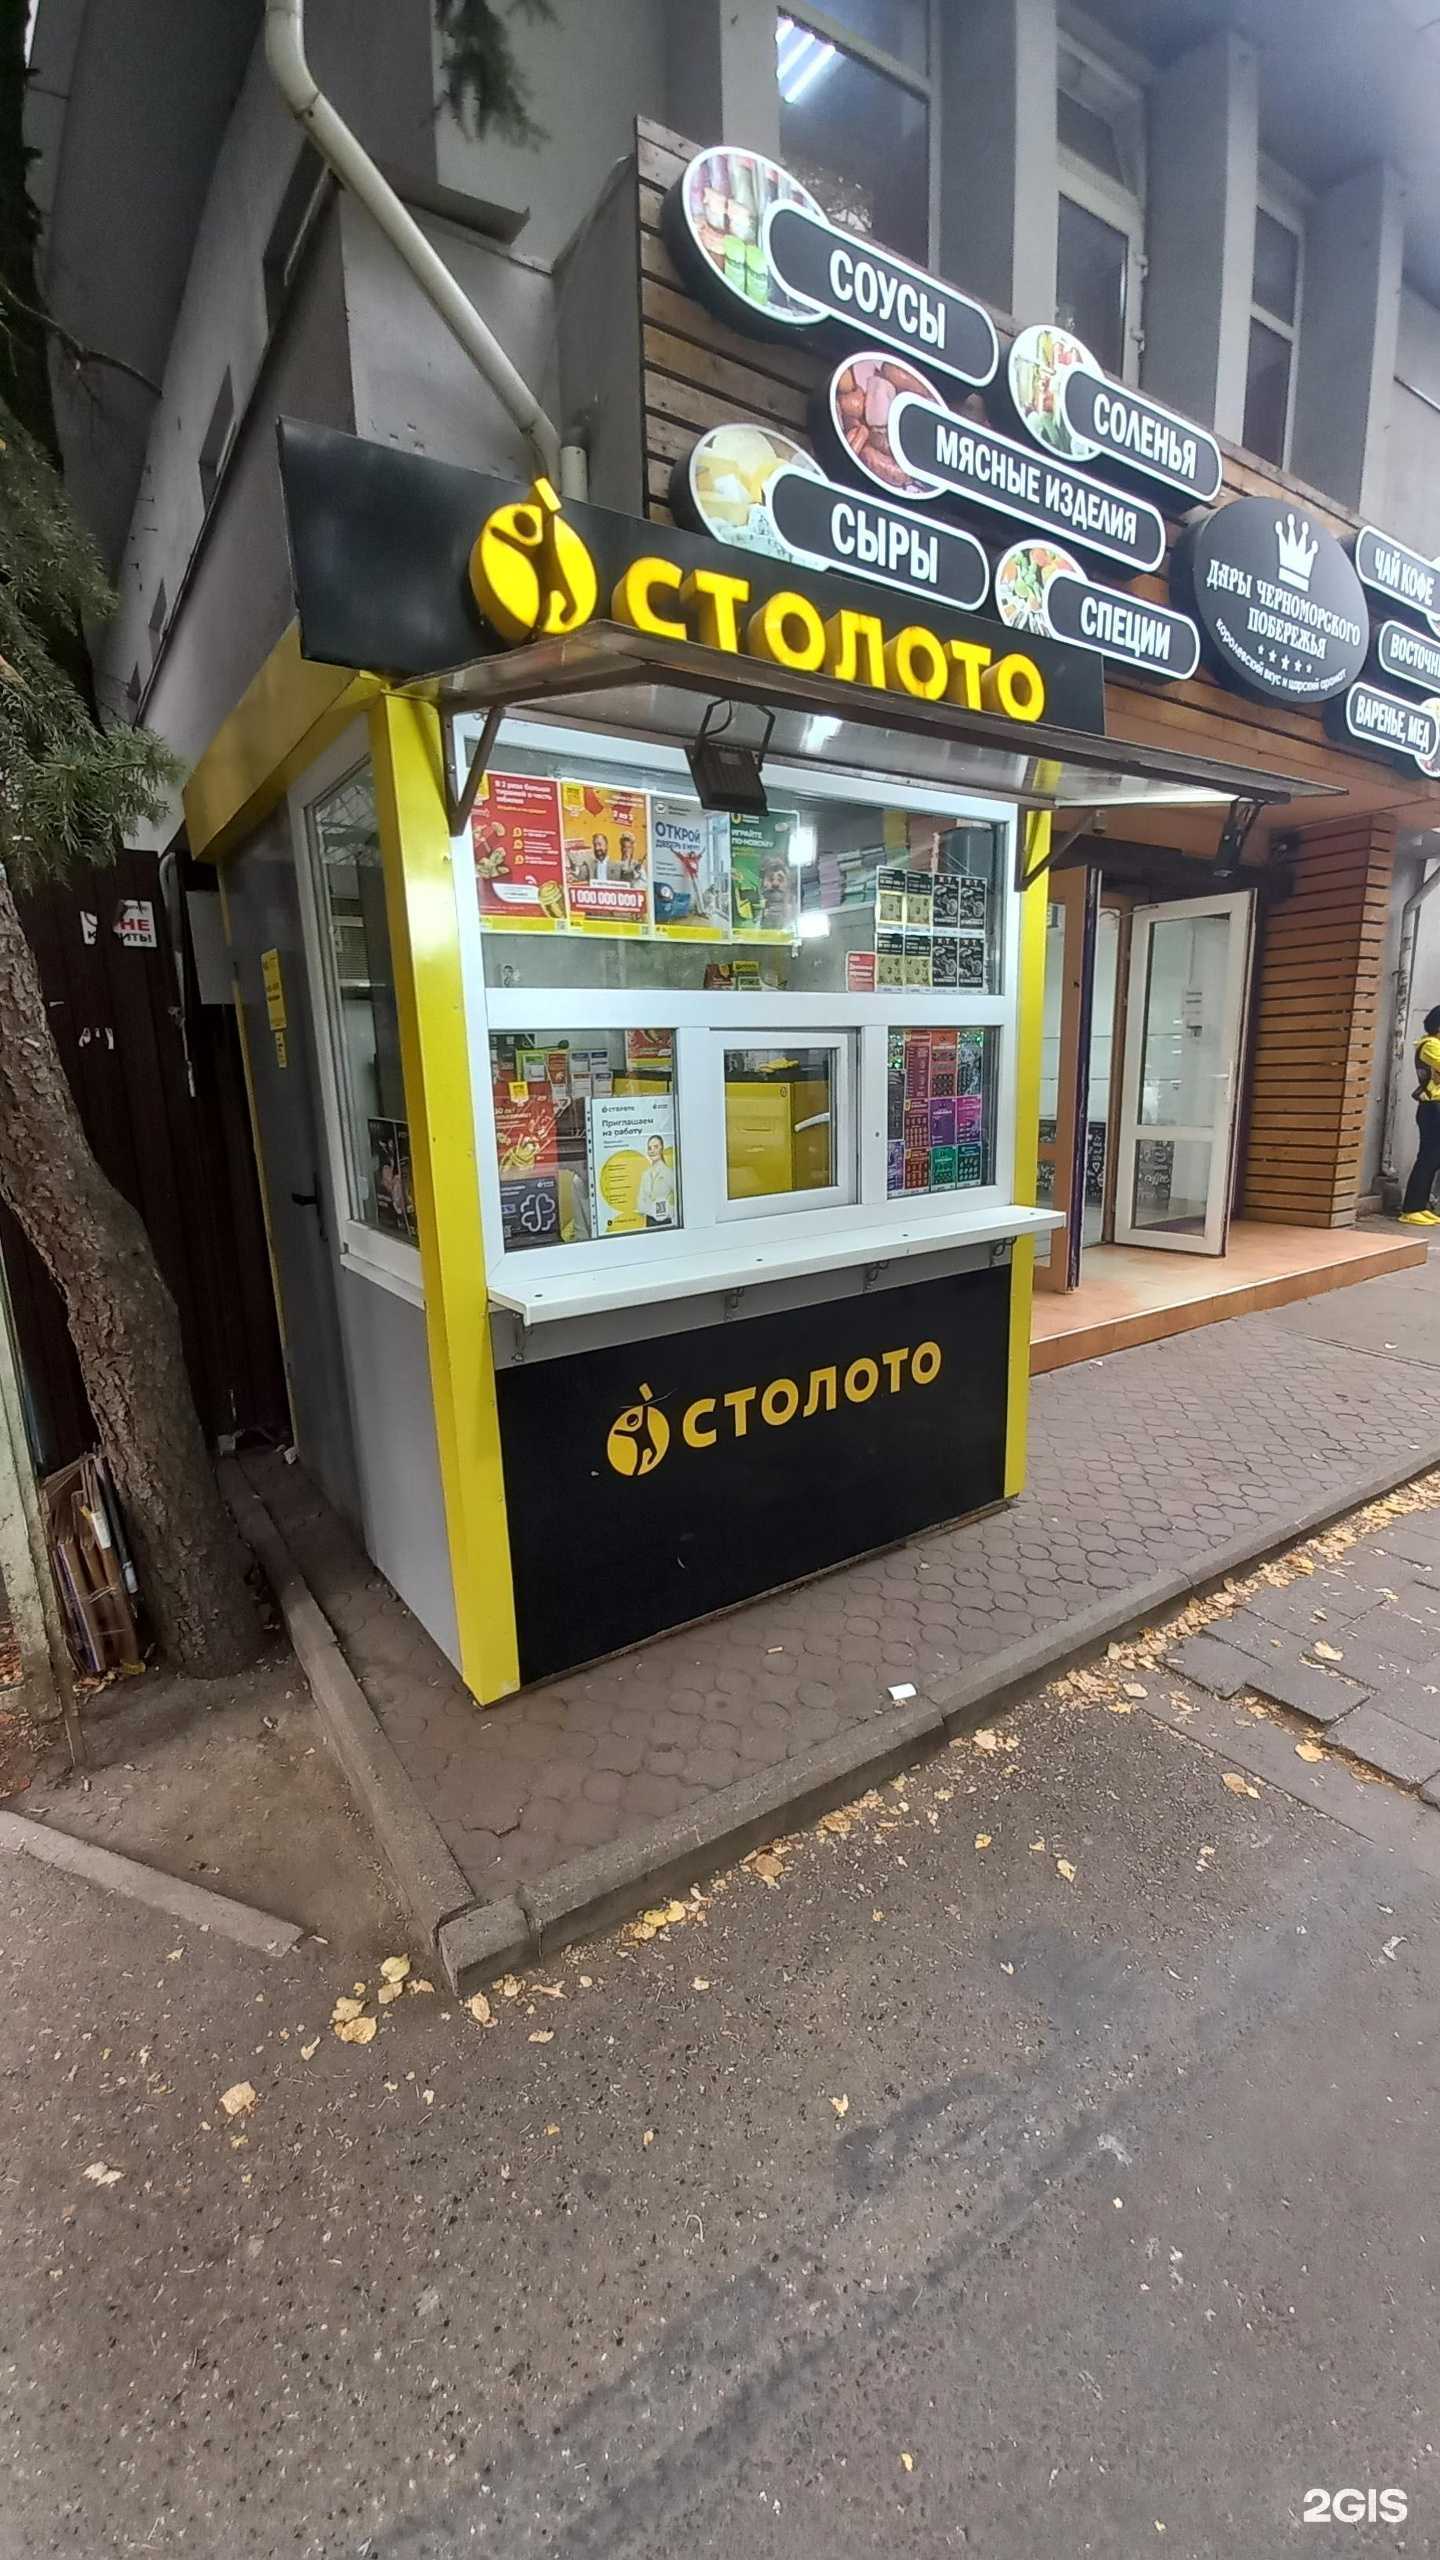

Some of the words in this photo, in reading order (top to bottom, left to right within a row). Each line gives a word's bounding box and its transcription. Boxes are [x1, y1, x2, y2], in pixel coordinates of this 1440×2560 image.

[829, 249, 946, 350] СОУСЫ
[1093, 392, 1197, 480] СОЛЕНЬЯ
[936, 424, 1041, 504] МЯСНЫЕ
[1044, 474, 1137, 545] ИЗДЕЛИЯ
[831, 502, 939, 584] СЫРЫ
[1206, 559, 1252, 599] ДАРЫ
[1256, 579, 1361, 646] ЧЕРНОМОРСКОГО
[1374, 547, 1401, 588] ЧАЙ
[1400, 563, 1435, 607] КОФЕ
[612, 556, 1046, 724] СТОЛОТО
[1080, 596, 1171, 661] СПЕЦИИ
[1247, 607, 1328, 660] ПОБЕРЕЖЬЯ
[1390, 633, 1440, 678] ВОСТОЧН
[1355, 695, 1406, 744] ВАРЕНЬЕ,
[1407, 715, 1430, 753] МЕД
[655, 821, 701, 843] ОТКРОЙ
[121, 919, 150, 931] НЕ
[601, 1118, 654, 1129] Приглашаем
[614, 1127, 643, 1138] работу
[682, 1341, 942, 1448] СТОЛОТО
